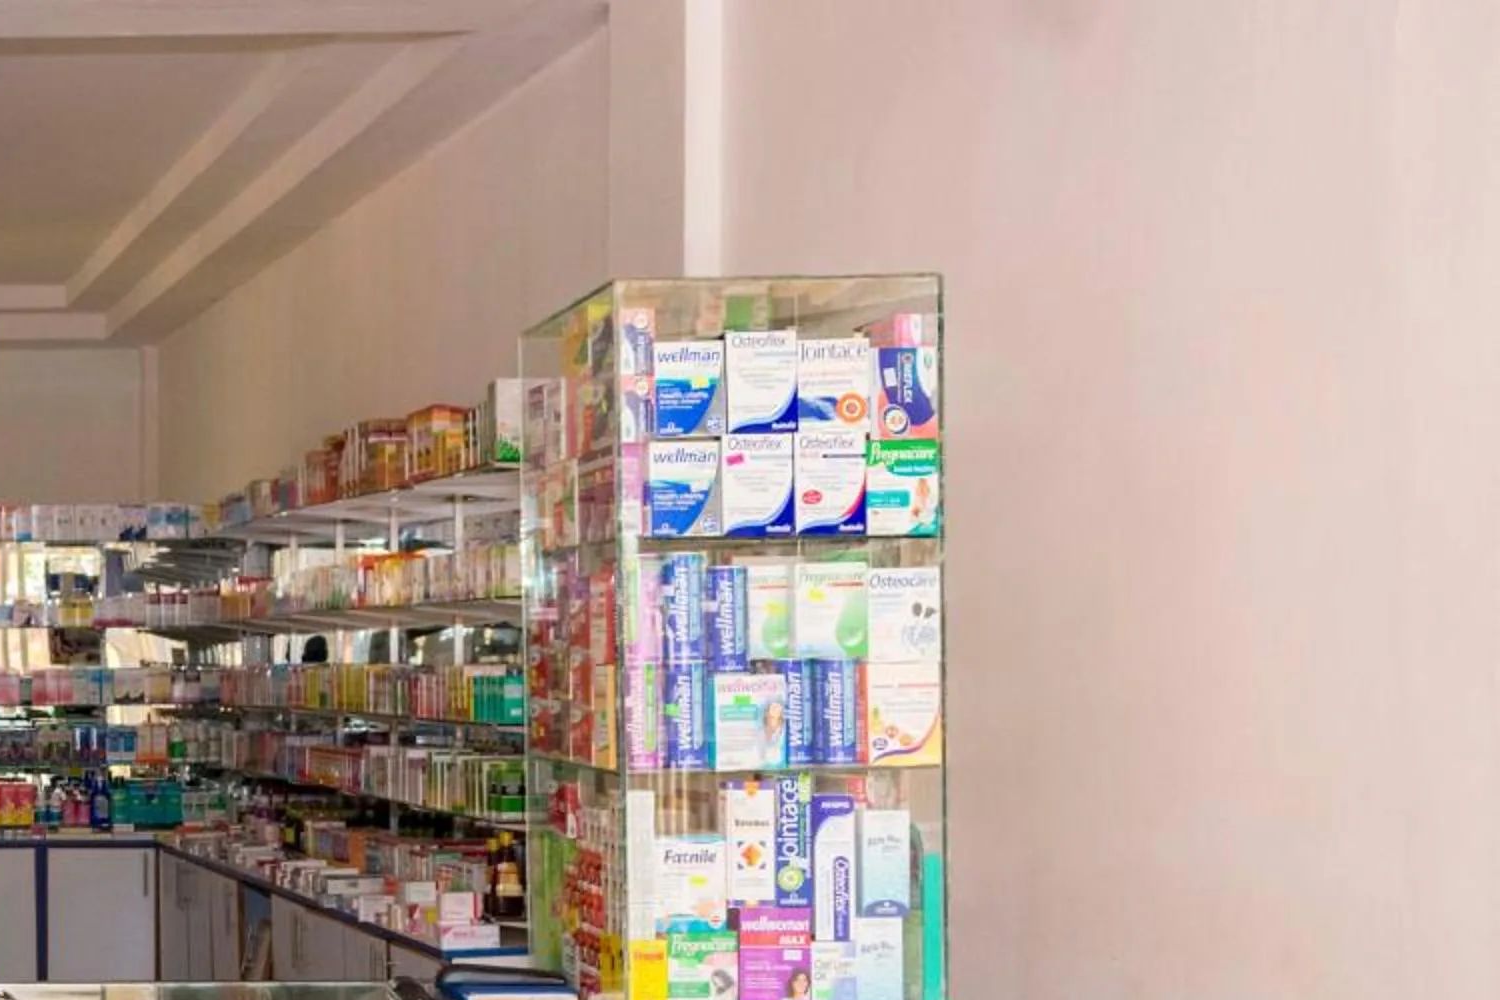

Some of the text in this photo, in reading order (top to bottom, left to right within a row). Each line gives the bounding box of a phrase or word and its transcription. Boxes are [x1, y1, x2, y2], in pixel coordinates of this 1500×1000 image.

[657, 348, 720, 363] wellman
[653, 449, 716, 463] wellman
[674, 566, 689, 642] wellman
[715, 580, 733, 655] wellman
[677, 675, 692, 750] wellman
[785, 671, 801, 747] wellman
[826, 671, 843, 747] wellman
[778, 775, 799, 867] Jointace
